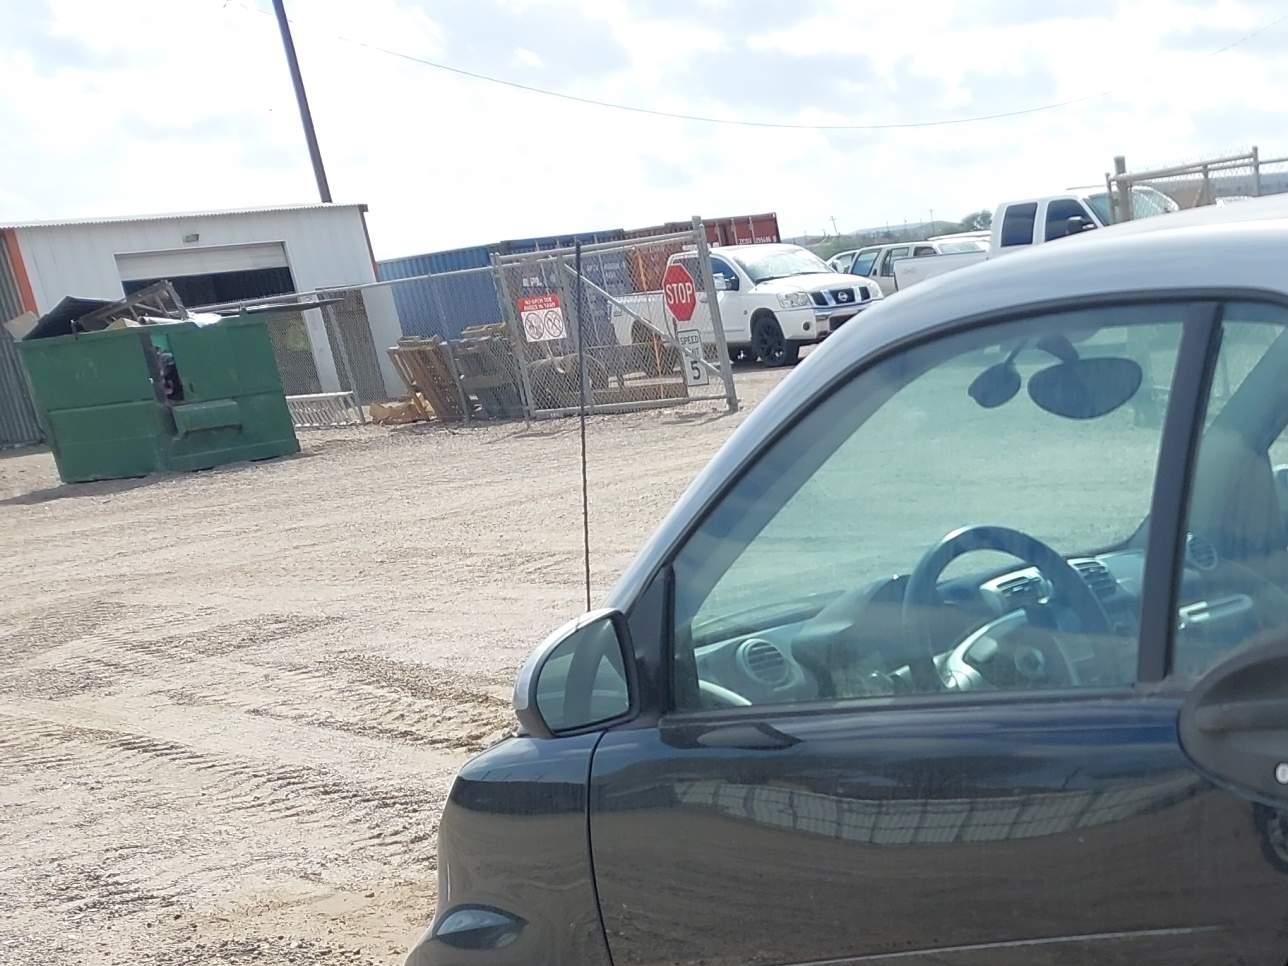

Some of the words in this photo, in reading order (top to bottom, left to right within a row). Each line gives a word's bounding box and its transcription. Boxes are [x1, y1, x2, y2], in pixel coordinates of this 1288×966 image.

[665, 282, 693, 304] STOP
[680, 335, 699, 346] SPEED
[691, 360, 701, 380] 5
